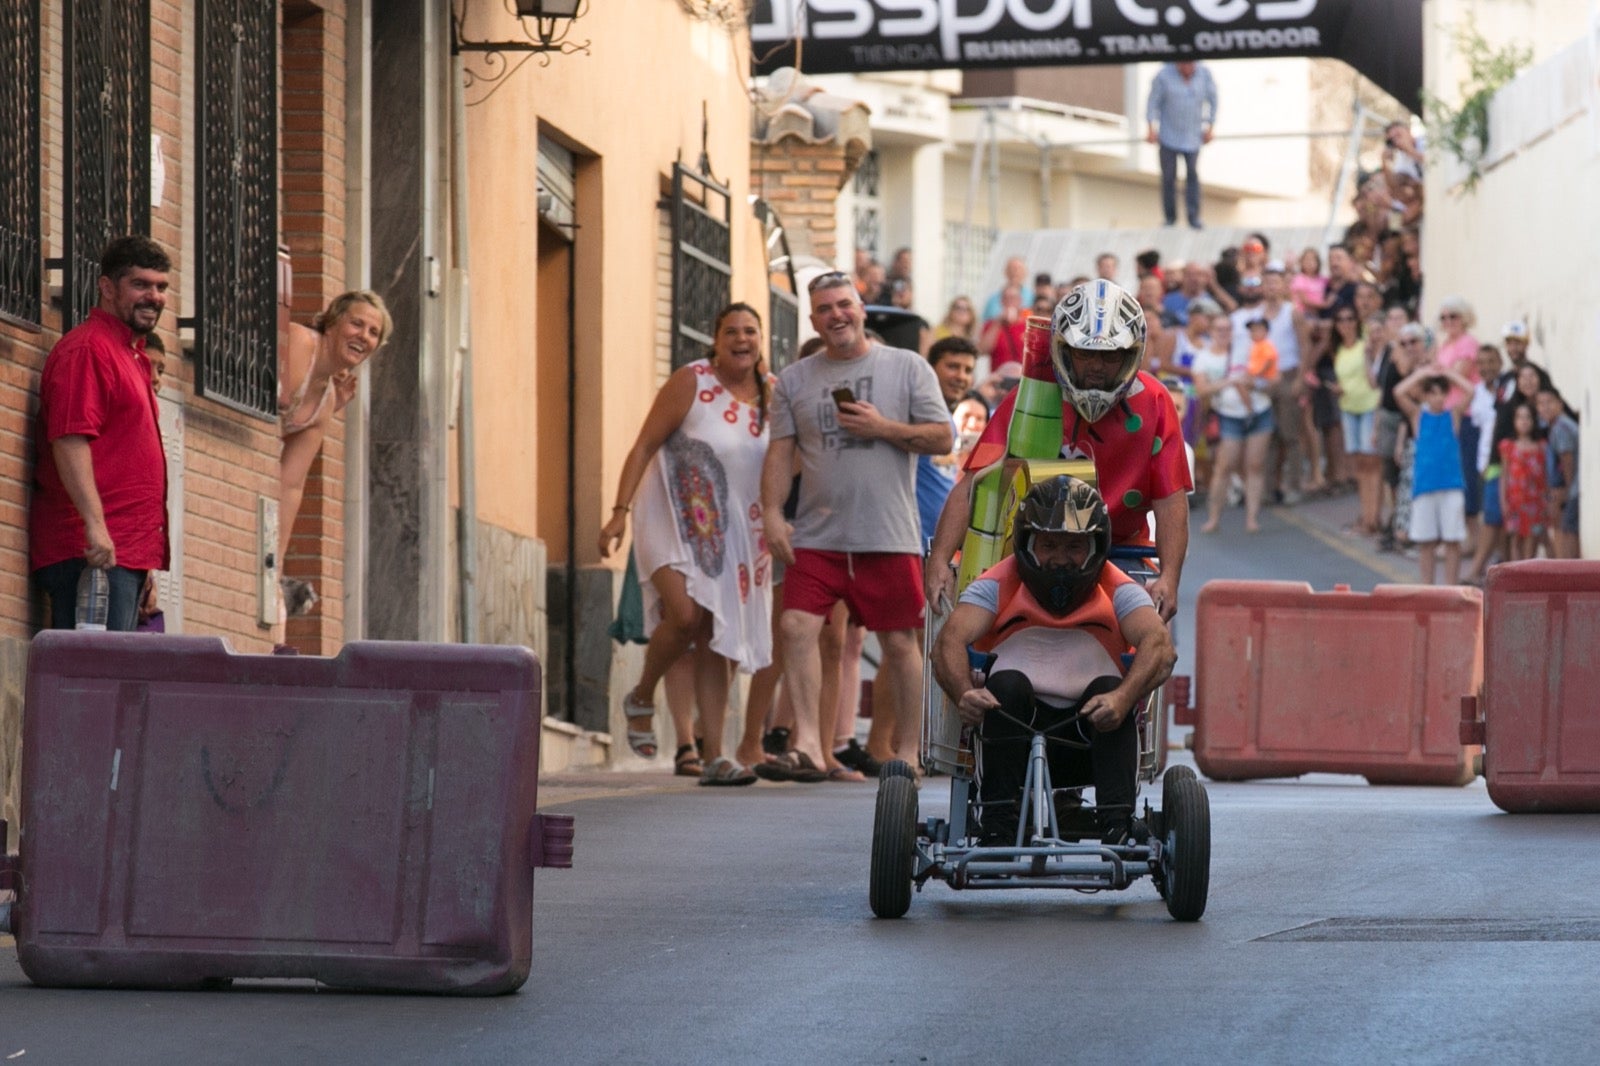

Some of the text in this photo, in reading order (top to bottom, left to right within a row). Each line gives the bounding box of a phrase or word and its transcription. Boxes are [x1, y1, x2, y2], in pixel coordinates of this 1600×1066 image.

[852, 26, 1320, 63] TIENDA RUNNING TRAIL OUTDOOR
